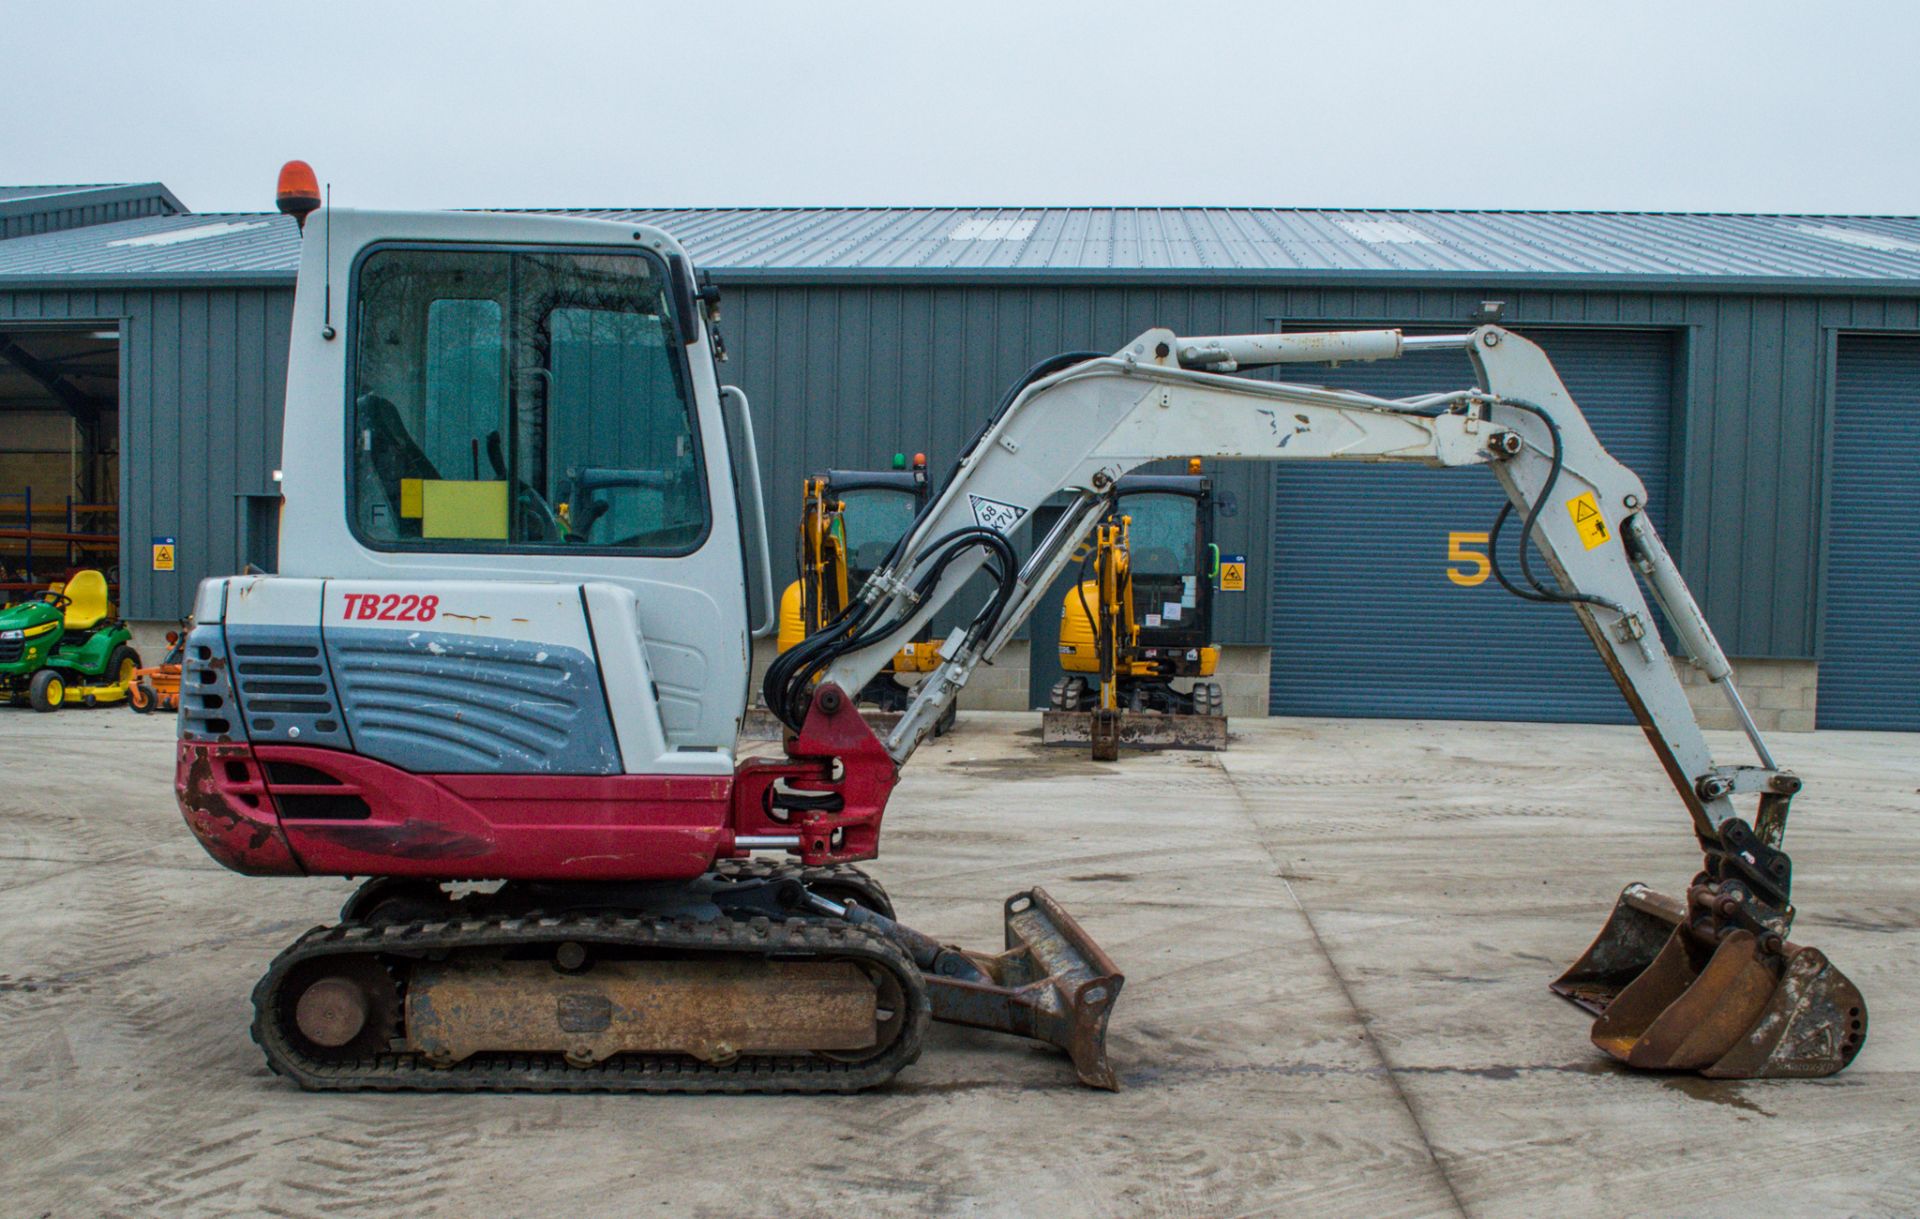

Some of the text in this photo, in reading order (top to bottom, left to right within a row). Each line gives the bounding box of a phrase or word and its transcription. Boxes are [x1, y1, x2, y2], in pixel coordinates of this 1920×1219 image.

[981, 505, 997, 522] 68
[990, 507, 1013, 530] K7V
[1447, 531, 1492, 587] 5
[343, 593, 440, 622] TB228
